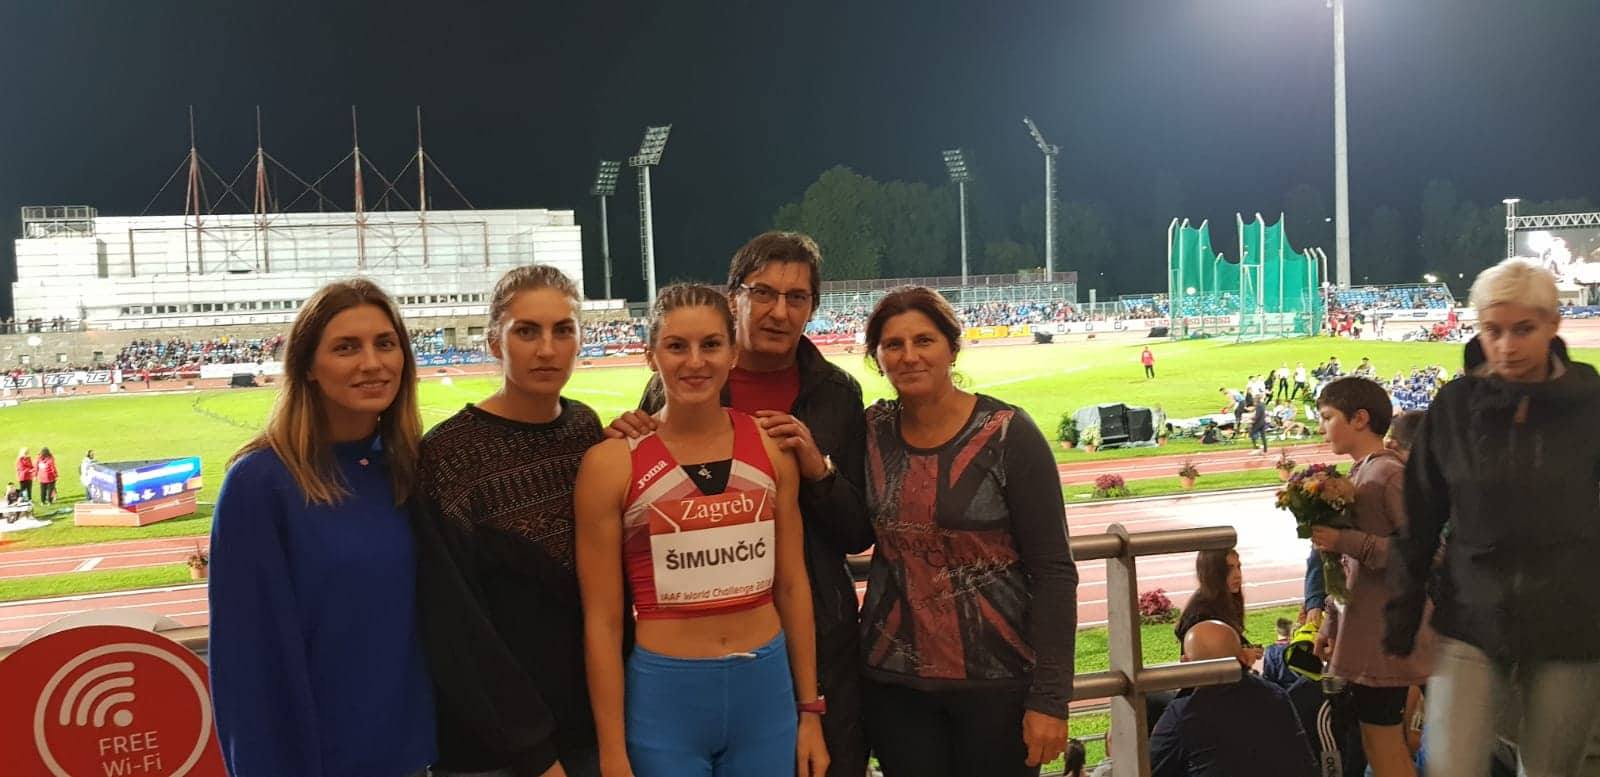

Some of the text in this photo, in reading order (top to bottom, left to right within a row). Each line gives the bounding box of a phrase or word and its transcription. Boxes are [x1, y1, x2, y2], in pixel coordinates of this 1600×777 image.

[681, 493, 753, 522] Zagreb
[666, 537, 766, 570] ŠIMUNČIĆ
[661, 591, 681, 601] IAAF
[684, 589, 710, 600] World
[712, 583, 754, 597] Challenge
[99, 731, 159, 756] FREE
[103, 752, 163, 777] Wi-Fi
